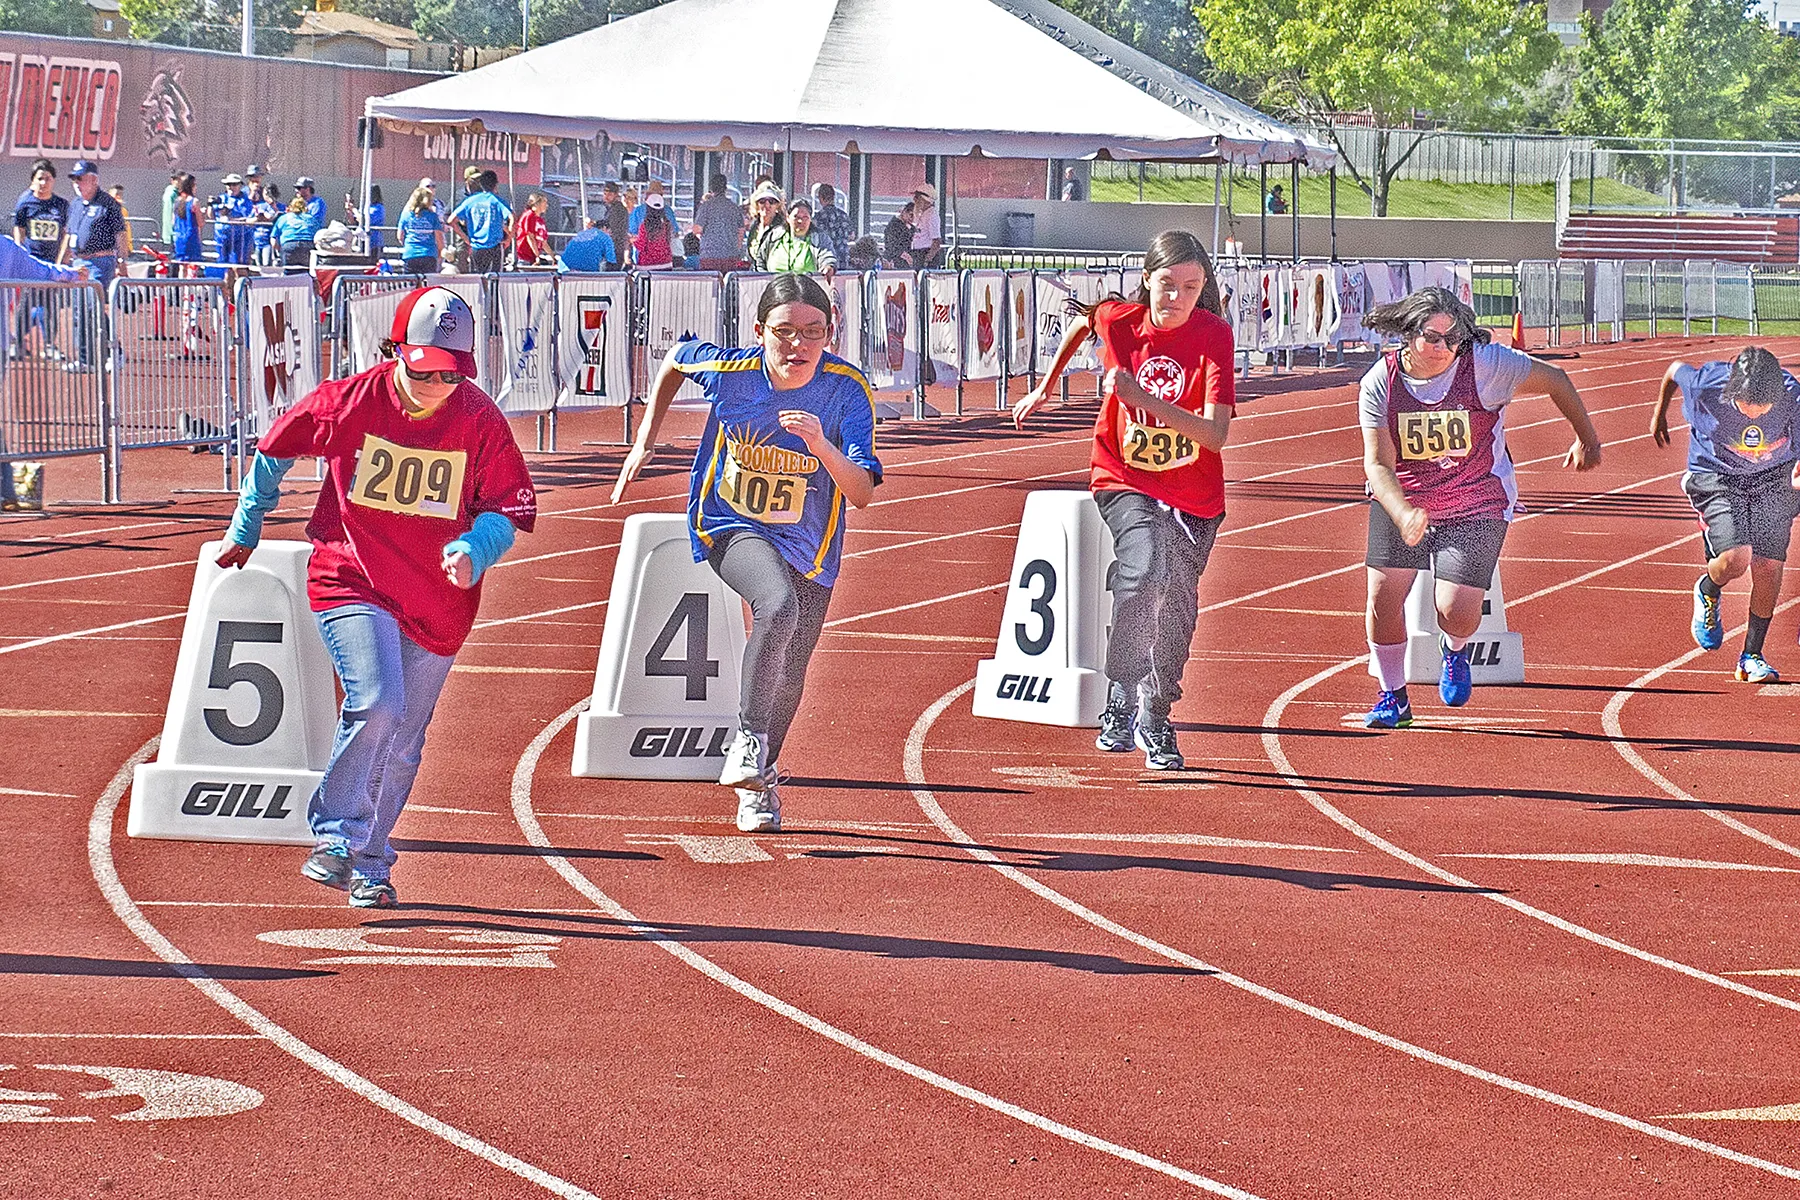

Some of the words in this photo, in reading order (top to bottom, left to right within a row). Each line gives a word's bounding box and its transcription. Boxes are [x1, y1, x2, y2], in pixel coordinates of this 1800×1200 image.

[11, 57, 120, 157] MEXICO
[1131, 429, 1194, 465] 238
[1407, 418, 1467, 455] 558
[363, 449, 453, 505] 209
[732, 472, 795, 514] 105
[1015, 559, 1057, 656] 3
[645, 593, 719, 701] 4
[1467, 641, 1501, 666] ILL
[203, 621, 284, 746] 5
[996, 673, 1053, 703] GILL
[629, 727, 729, 758] GILL
[181, 781, 293, 820] GILL
